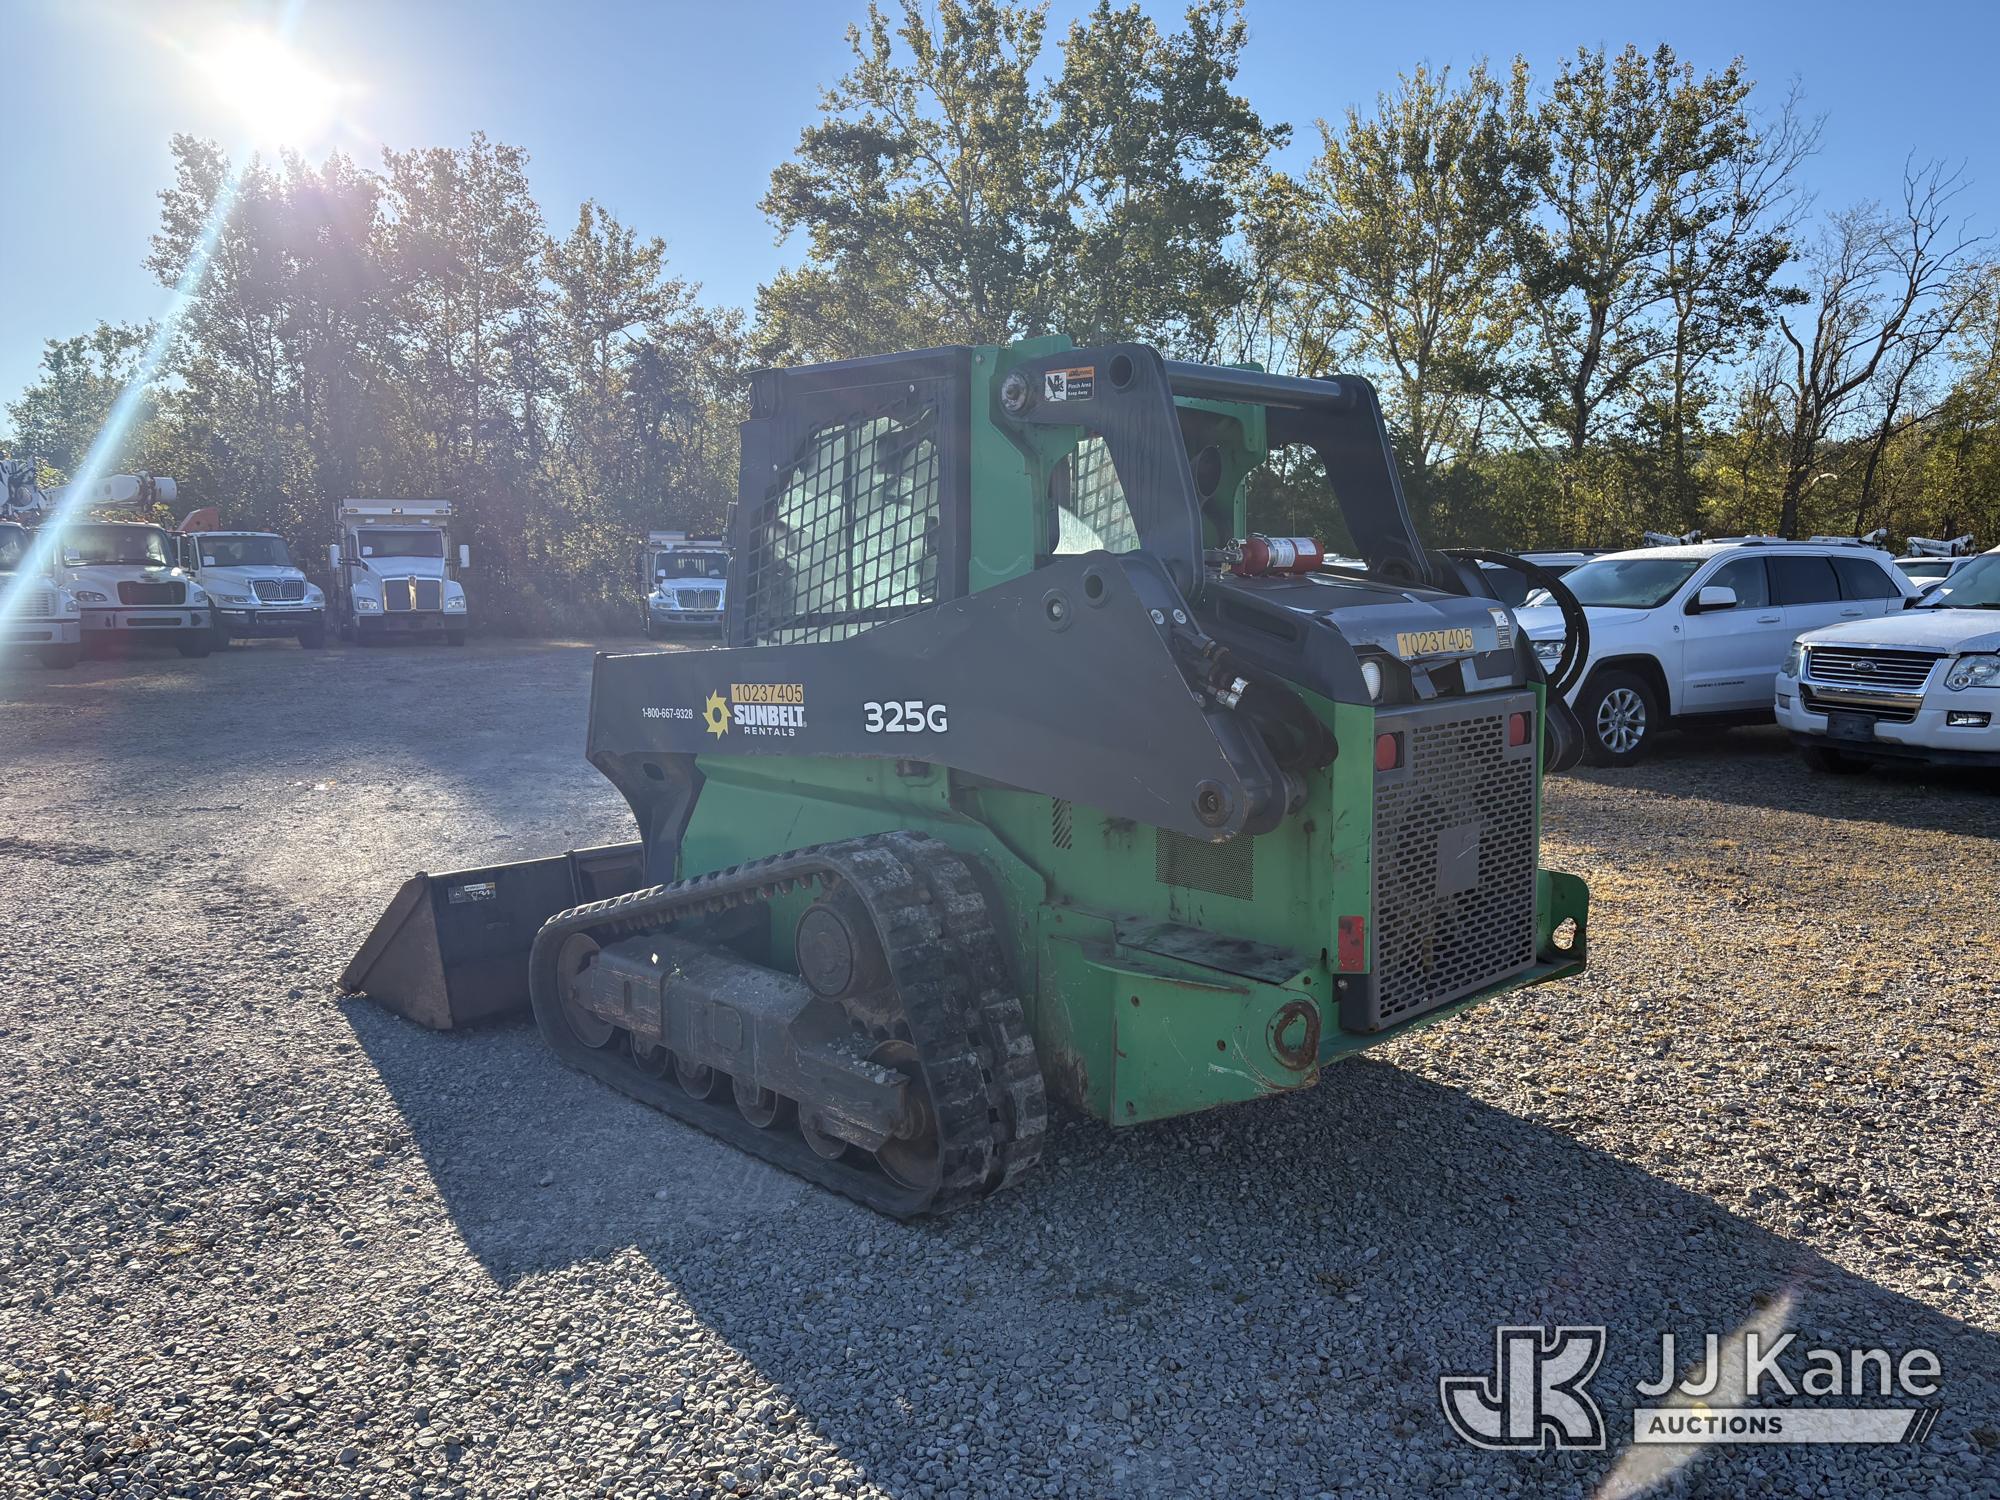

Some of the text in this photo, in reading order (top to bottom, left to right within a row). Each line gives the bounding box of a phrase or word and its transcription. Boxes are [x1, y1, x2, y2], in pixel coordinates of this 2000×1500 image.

[1402, 628, 1473, 656] 10237405
[735, 684, 803, 703] 10237405
[642, 707, 694, 720] 1-800-667-9328
[733, 704, 805, 727] SUNBELT
[863, 701, 948, 733] 325G
[744, 727, 796, 737] RENTALS
